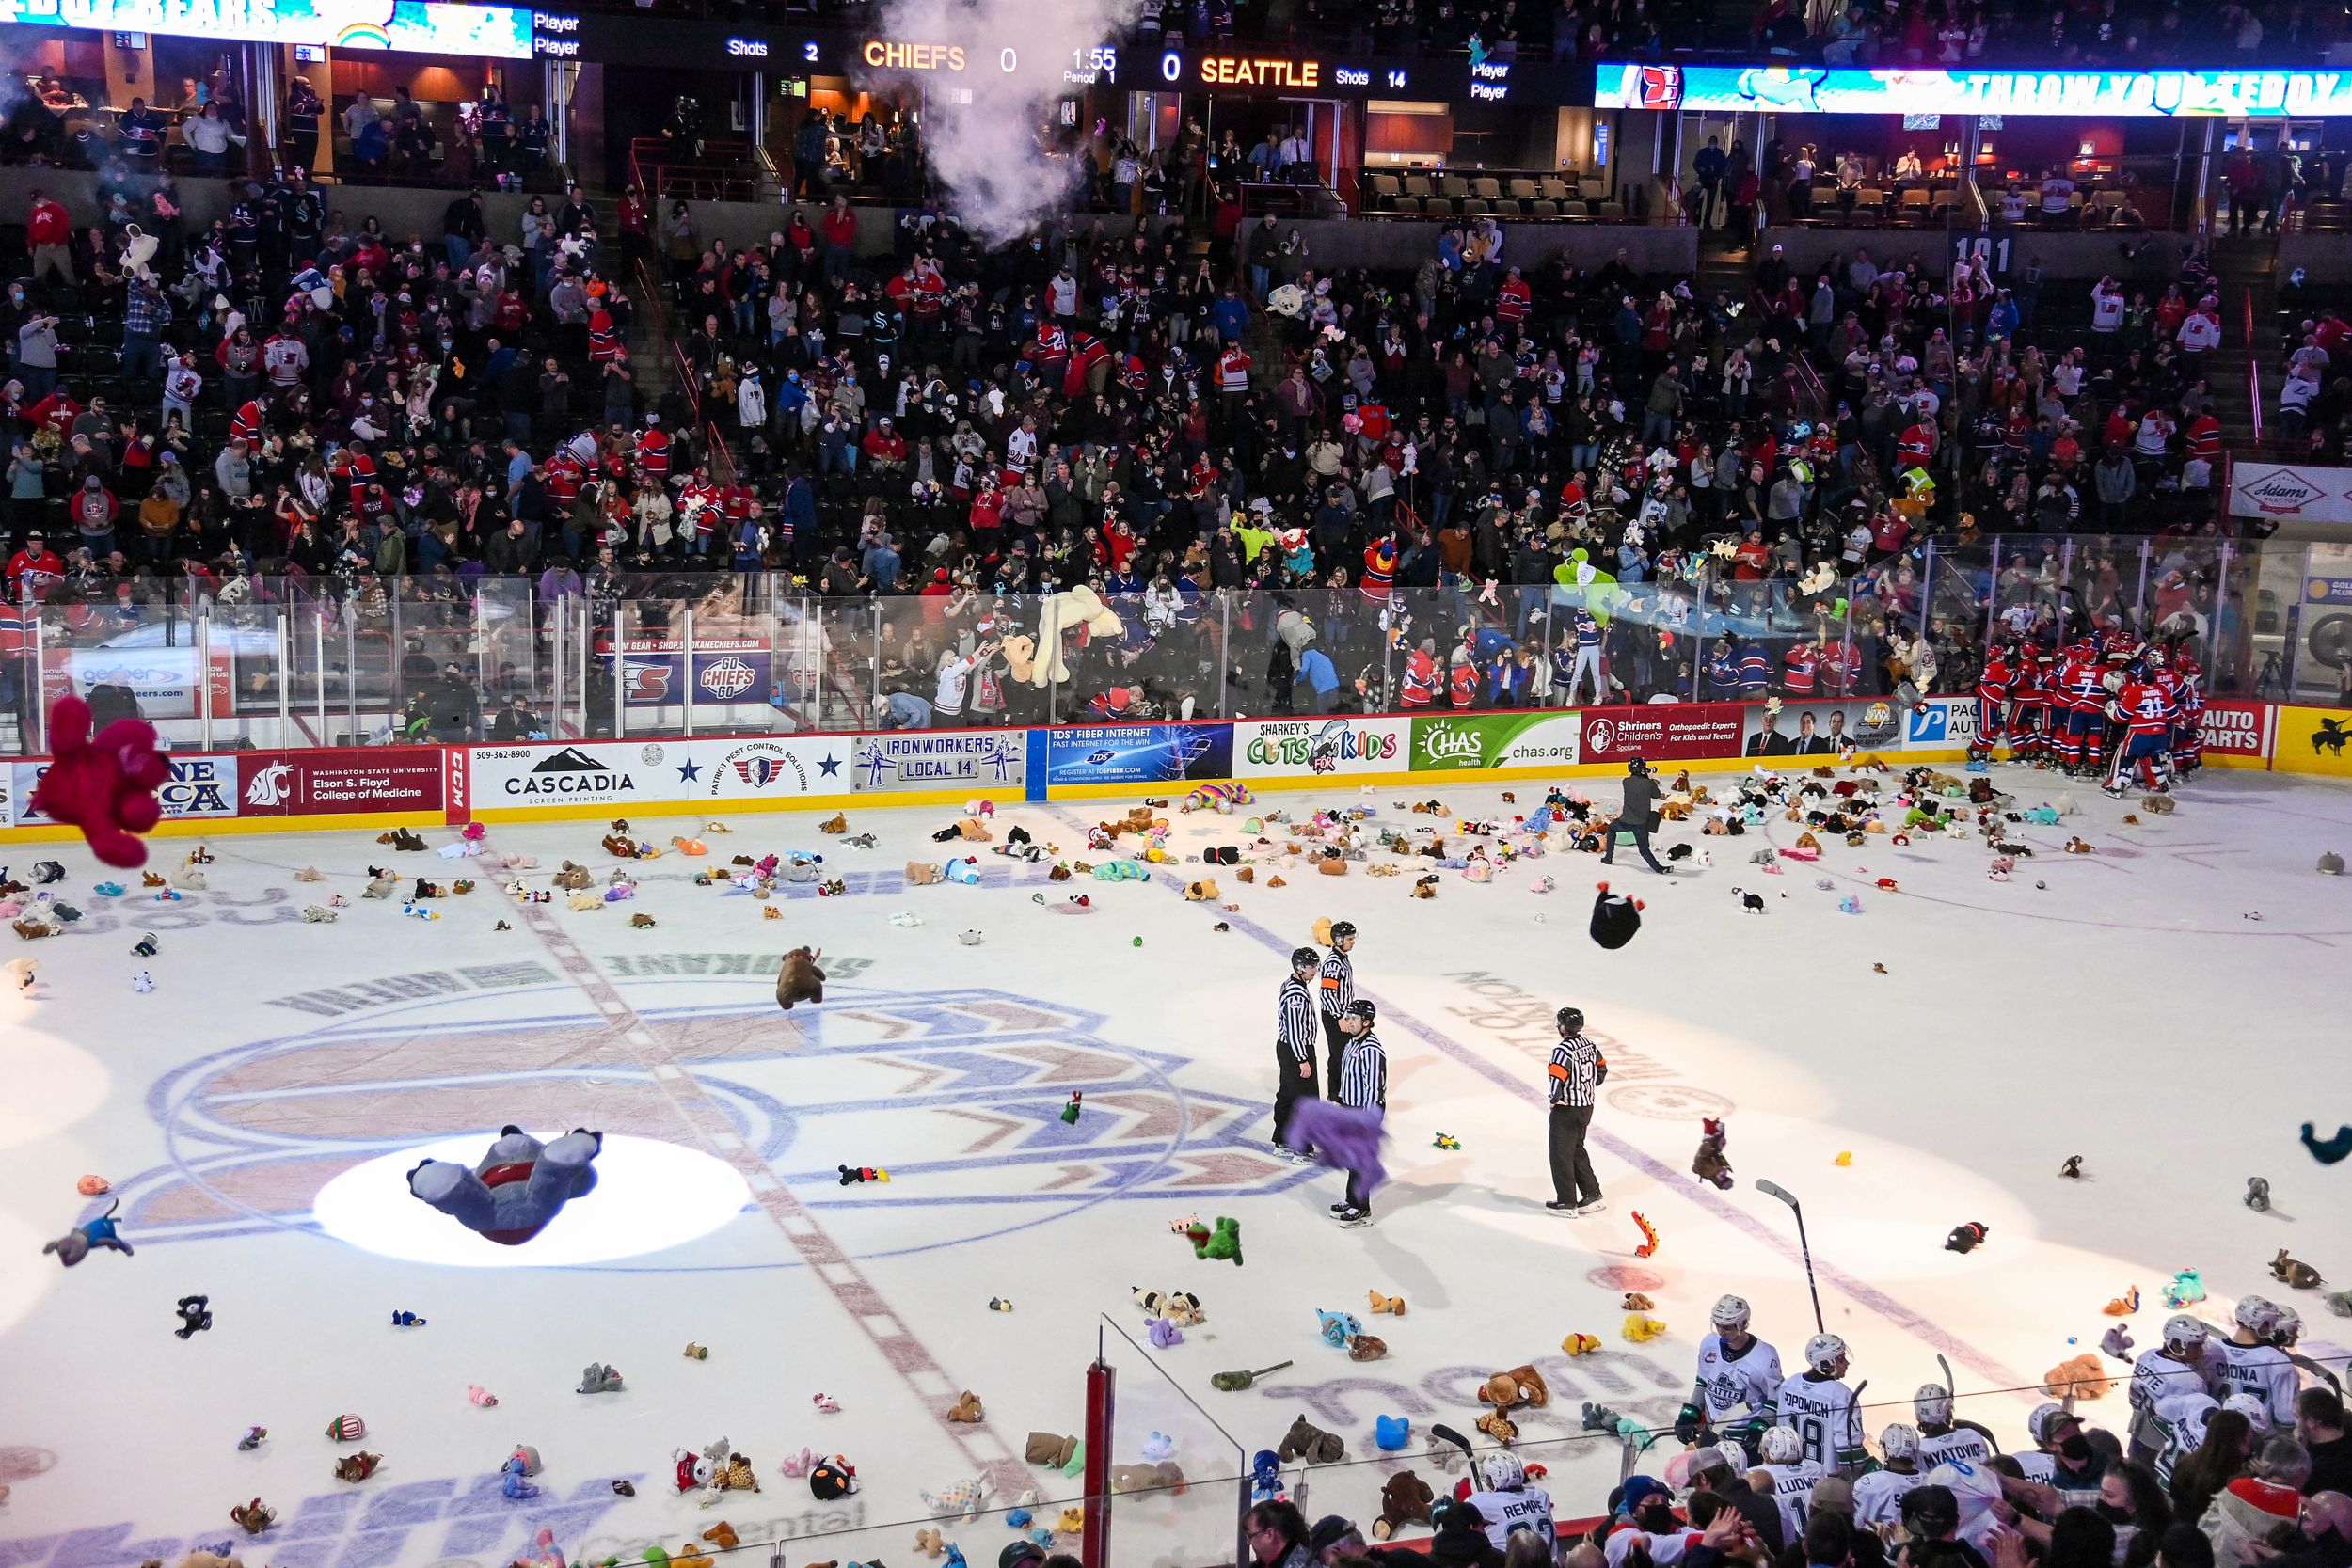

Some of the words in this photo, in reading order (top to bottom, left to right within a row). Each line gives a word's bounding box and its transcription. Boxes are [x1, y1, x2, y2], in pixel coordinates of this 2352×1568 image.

[533, 13, 579, 33] Player
[533, 38, 579, 56] Player
[728, 40, 767, 56] Shots
[806, 45, 818, 61] 2
[864, 42, 965, 71] CHIEFS
[1000, 48, 1017, 72] 0
[1073, 48, 1116, 71] 1:55
[1063, 71, 1096, 85] Period
[1109, 71, 1116, 84] 1
[1163, 54, 1180, 81] 0
[1200, 57, 1318, 87] SEATTLE
[1336, 71, 1370, 86] Shots
[1388, 71, 1406, 87] 14
[1472, 64, 1509, 79] Player
[1470, 83, 1507, 101] Player
[1966, 74, 2102, 109] THROW
[2215, 74, 2341, 110] TEDDY
[1956, 237, 2010, 273] 101
[2254, 483, 2309, 499] Adams
[631, 641, 651, 650] GEAR
[659, 640, 760, 650] SHOP.SOKANECHIEFS.COM
[722, 657, 738, 670] GO
[701, 669, 755, 687] CHIEFS
[717, 686, 735, 699] GO
[2081, 678, 2093, 698] 7
[2140, 697, 2164, 719] 31
[1618, 721, 1661, 731] Shriners
[1669, 722, 1711, 733] Orthopaedic
[1712, 722, 1738, 731] Experts
[2200, 709, 2255, 730] AUTO
[1076, 729, 1103, 739] FIBER
[1106, 728, 1151, 738] INTERNET
[1260, 722, 1310, 736] SHARKEY'S
[1712, 732, 1734, 740] Teens!
[886, 736, 993, 755] IRONWORKERS
[1071, 739, 1103, 748] INTERNET
[1426, 729, 1482, 759] CHAS
[1616, 744, 1642, 752] Spokane
[2196, 729, 2258, 750] PARTS
[476, 750, 531, 760] 509-362-8900
[1247, 736, 1310, 765] CUTS
[1312, 756, 1336, 772] FOR
[1341, 730, 1397, 761] KIDS
[1513, 745, 1574, 760] chas.org
[711, 762, 728, 796] PATRIOT
[725, 747, 744, 763] PEST
[746, 742, 784, 754] CONTROL
[785, 752, 808, 792] SOLUTIONS
[906, 761, 952, 777] LOCAL
[957, 760, 972, 775] 14
[1459, 758, 1481, 767] health
[313, 779, 343, 788] Elson
[346, 779, 357, 787] S.
[359, 778, 390, 788] Floyd
[453, 752, 464, 808] CCM
[504, 774, 635, 795] CASCADIA
[313, 790, 356, 800] College
[358, 789, 371, 799] of
[373, 788, 421, 799] Medicine
[603, 953, 875, 979] SOKANE
[1580, 1061, 1593, 1083] 30
[2217, 1362, 2258, 1383] CIONA
[1707, 1382, 1740, 1400] SEATTLE
[1923, 1443, 1981, 1469] MYATOVIC
[1502, 1499, 1546, 1519] REMPE
